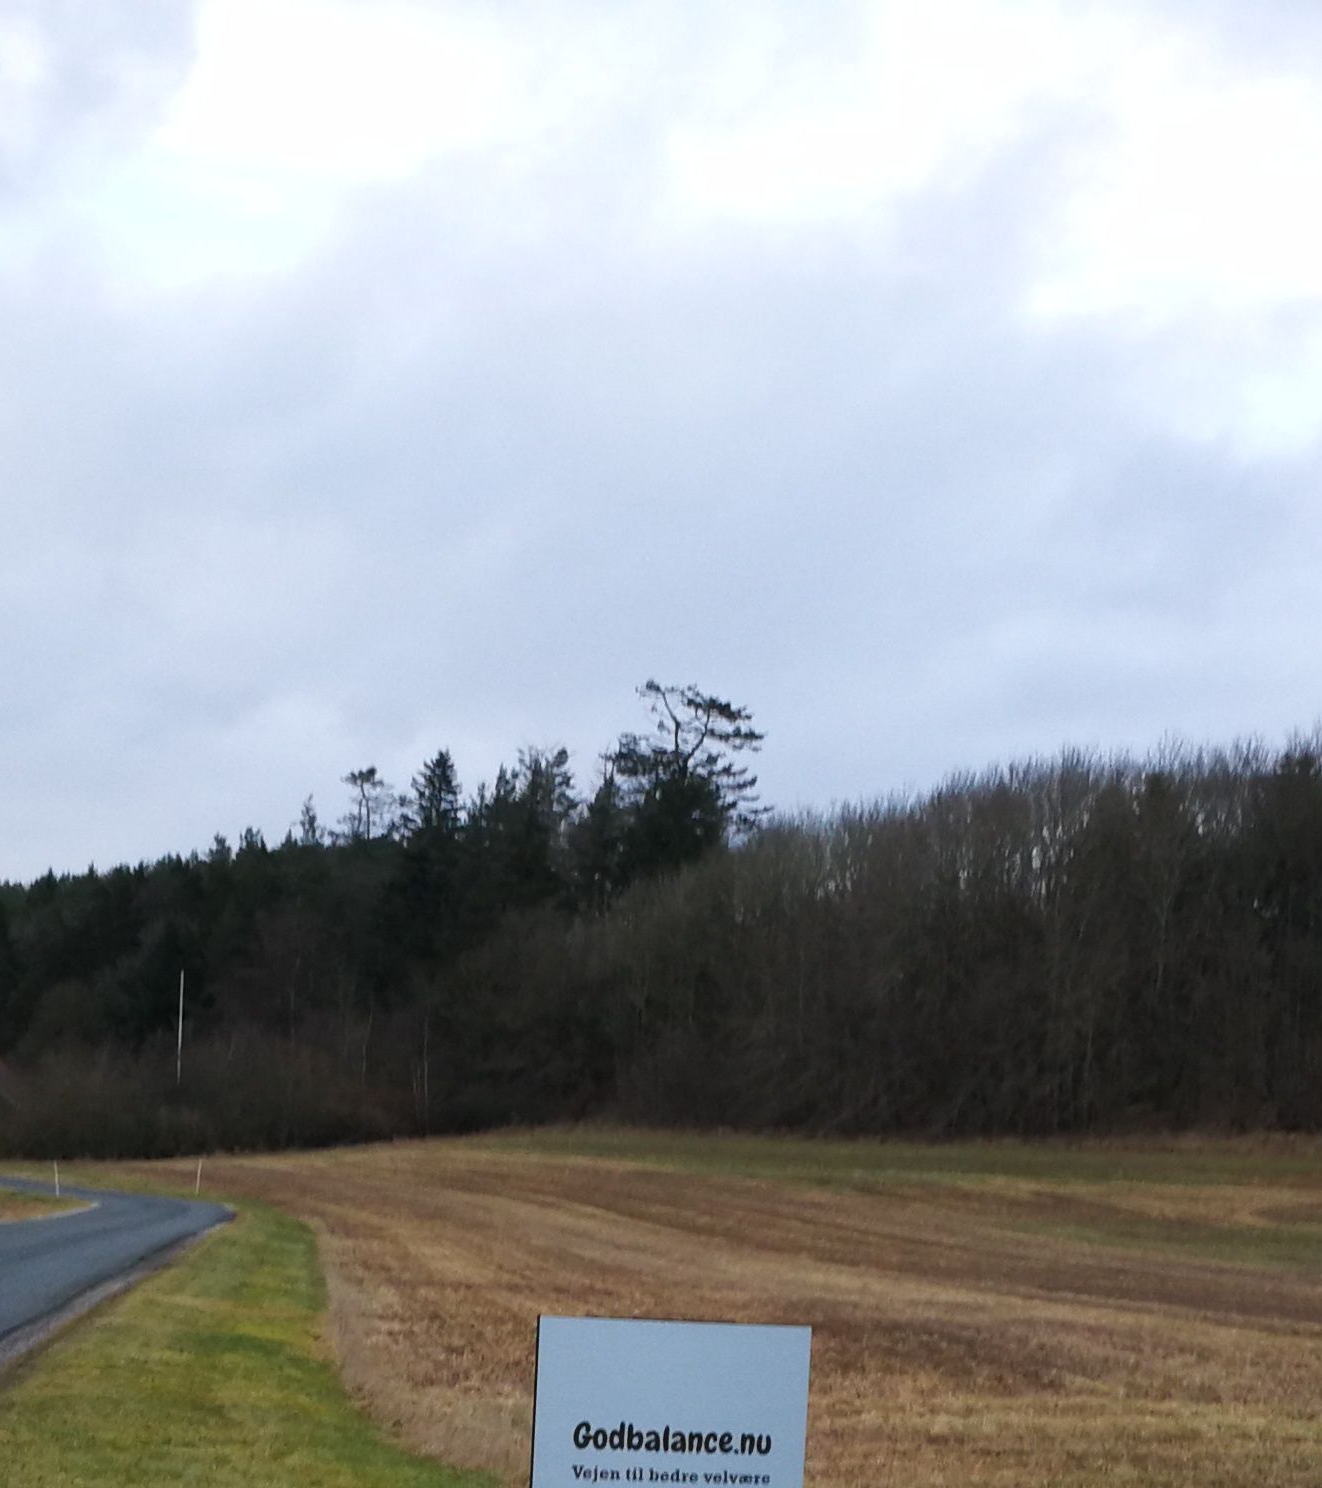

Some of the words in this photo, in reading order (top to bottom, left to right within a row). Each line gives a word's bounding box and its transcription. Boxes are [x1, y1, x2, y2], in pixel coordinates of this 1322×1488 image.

[573, 1421, 772, 1455] Godbalance.nu
[572, 1464, 620, 1483] Vejen
[626, 1467, 643, 1481] til
[649, 1467, 698, 1484] bedre
[704, 1469, 770, 1486] velvære
